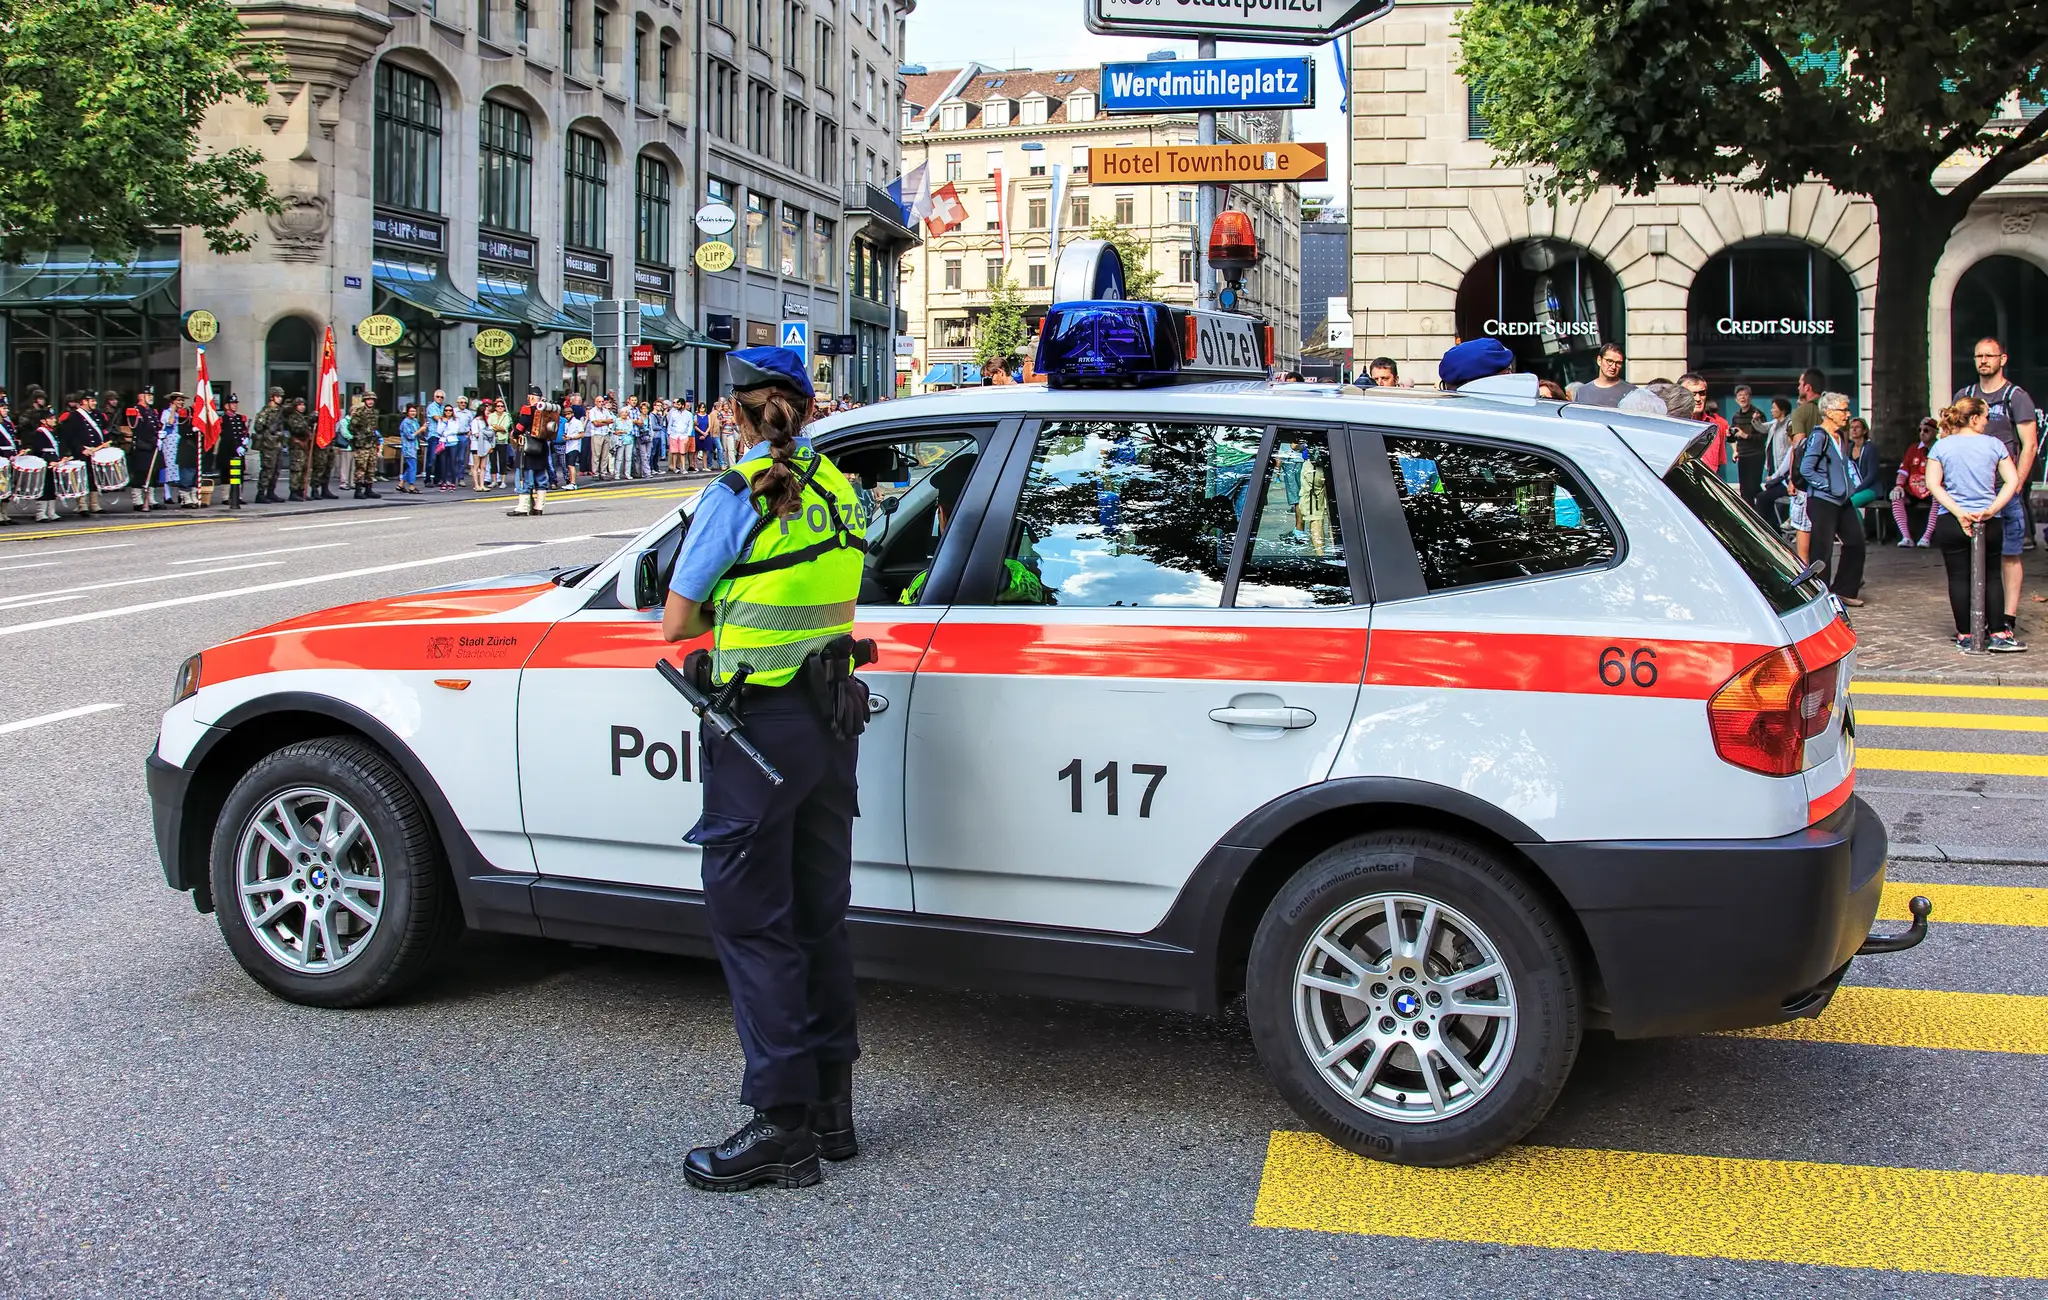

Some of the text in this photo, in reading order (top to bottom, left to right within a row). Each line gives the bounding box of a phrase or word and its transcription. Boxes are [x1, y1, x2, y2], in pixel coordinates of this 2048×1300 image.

[1110, 68, 1299, 100] Werdmühleplatz
[1103, 149, 1289, 175] Hotel Townhoue
[395, 221, 411, 239] LIPP
[494, 242, 508, 258] LIPP
[705, 251, 725, 261] LIPP
[565, 256, 597, 273] VÖGELE SHOES
[635, 270, 662, 286] VÖGELE SHOES
[369, 325, 392, 336] LIPP
[1483, 319, 1598, 335] CREDIT SUISSE
[1716, 318, 1834, 334] CREDIT SUISSE
[484, 338, 504, 348] LIPP
[1198, 316, 1260, 368] olizei
[570, 346, 589, 355] LIPP
[458, 636, 517, 647] Stadt Zürich
[455, 649, 507, 659] Stadtpolizei
[1598, 646, 1658, 688] 66
[1058, 758, 1168, 818] 117
[1288, 862, 1400, 919] ContiPremiumContact
